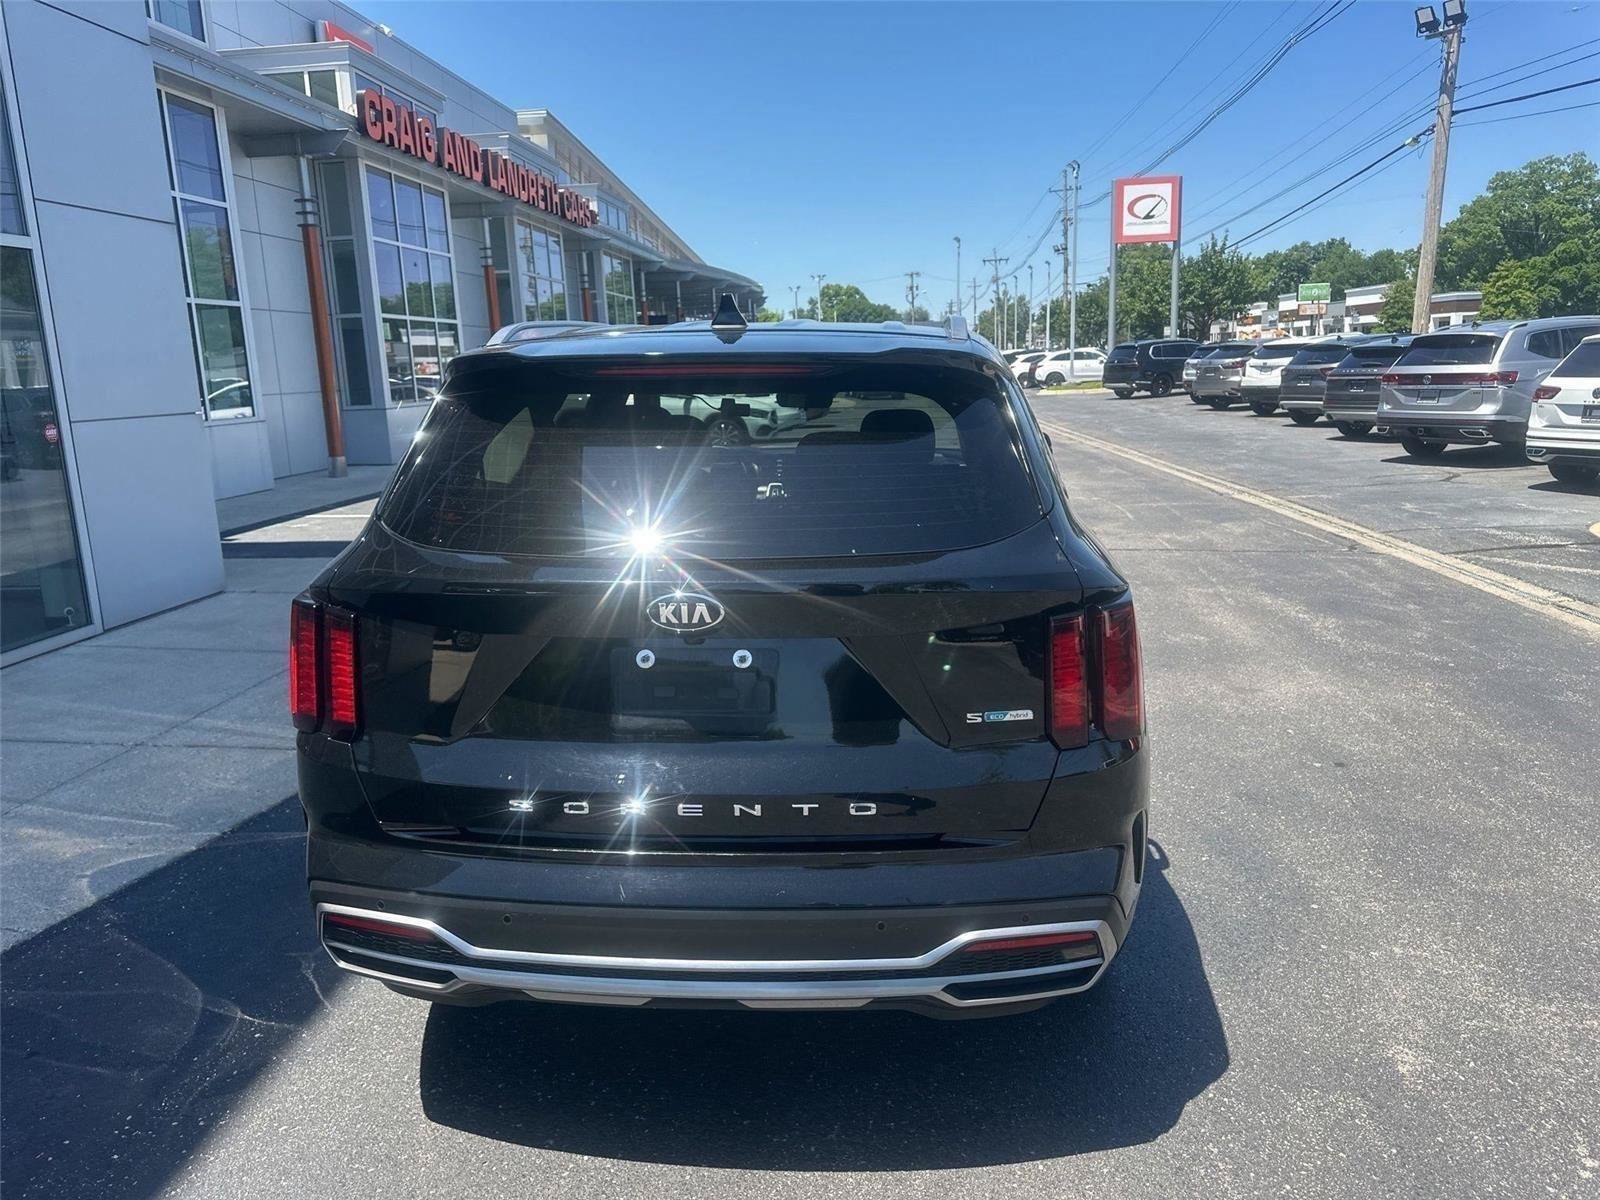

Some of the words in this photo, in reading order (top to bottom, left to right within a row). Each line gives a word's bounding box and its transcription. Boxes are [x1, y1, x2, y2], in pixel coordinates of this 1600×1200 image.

[359, 87, 437, 164] CRAIG
[443, 127, 483, 182] AND
[487, 149, 561, 216] LANDRETH
[562, 188, 594, 229] CARS
[658, 602, 712, 624] KIA
[508, 799, 877, 817] SORENTO
